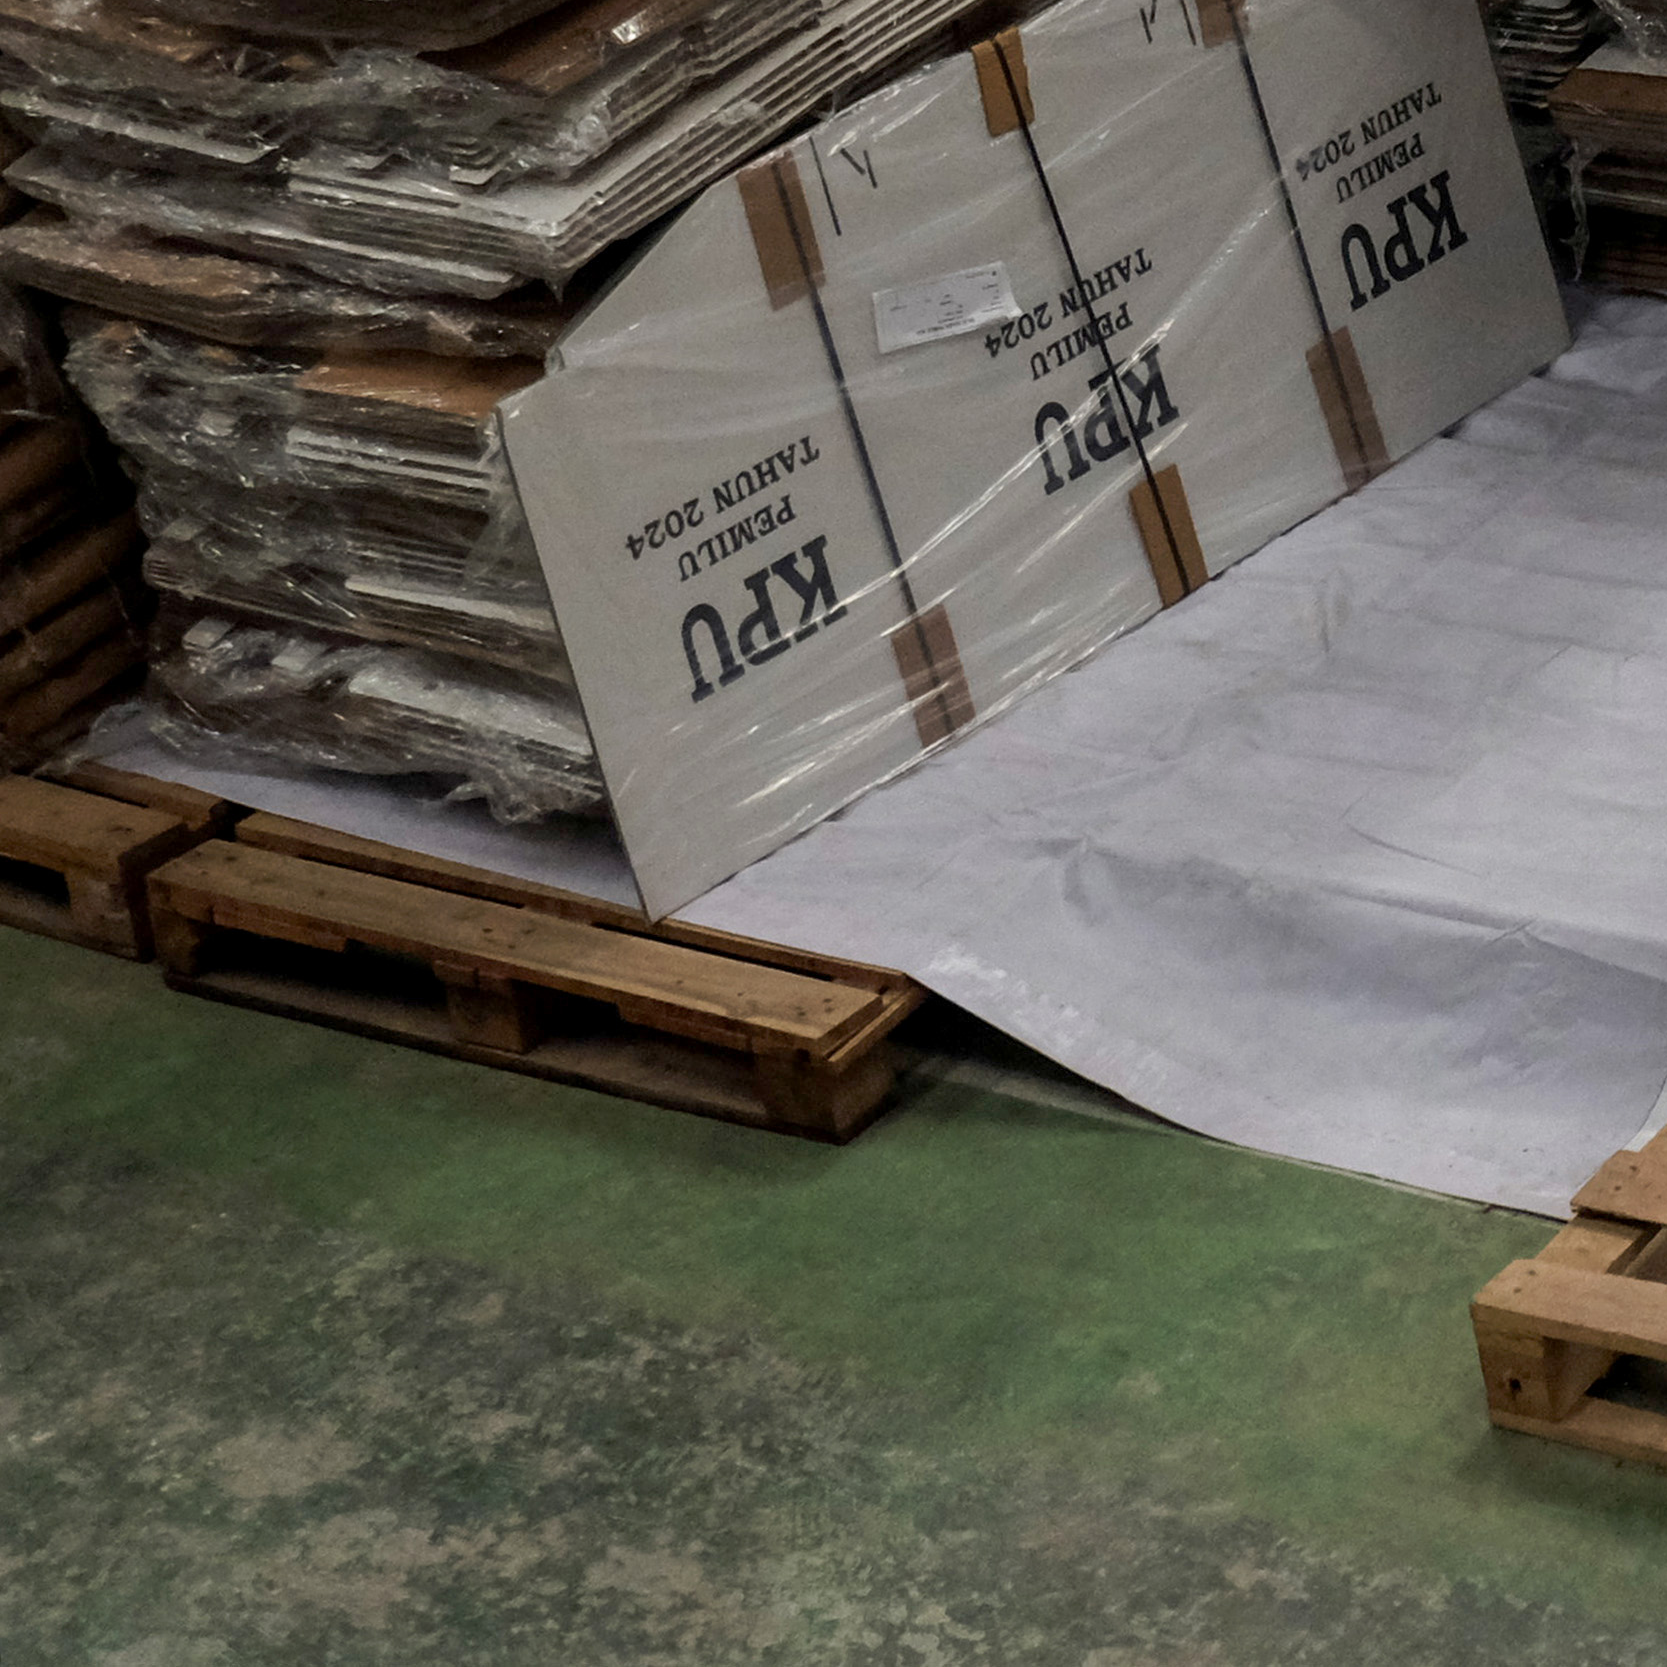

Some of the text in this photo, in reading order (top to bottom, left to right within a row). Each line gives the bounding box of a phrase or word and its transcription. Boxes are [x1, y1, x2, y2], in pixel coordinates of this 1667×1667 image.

[1296, 82, 1442, 182] TAHUN 2024
[1336, 132, 1426, 204] PEMILU
[1059, 247, 1152, 319] TAHUN
[1341, 170, 1469, 312] KPU
[984, 302, 1053, 359] 2024
[1029, 301, 1133, 381] PEMILU
[1035, 344, 1180, 496] KPU
[625, 435, 820, 561] TAHUN 2024
[677, 494, 797, 582] PEMILU
[681, 534, 848, 704] KPU
